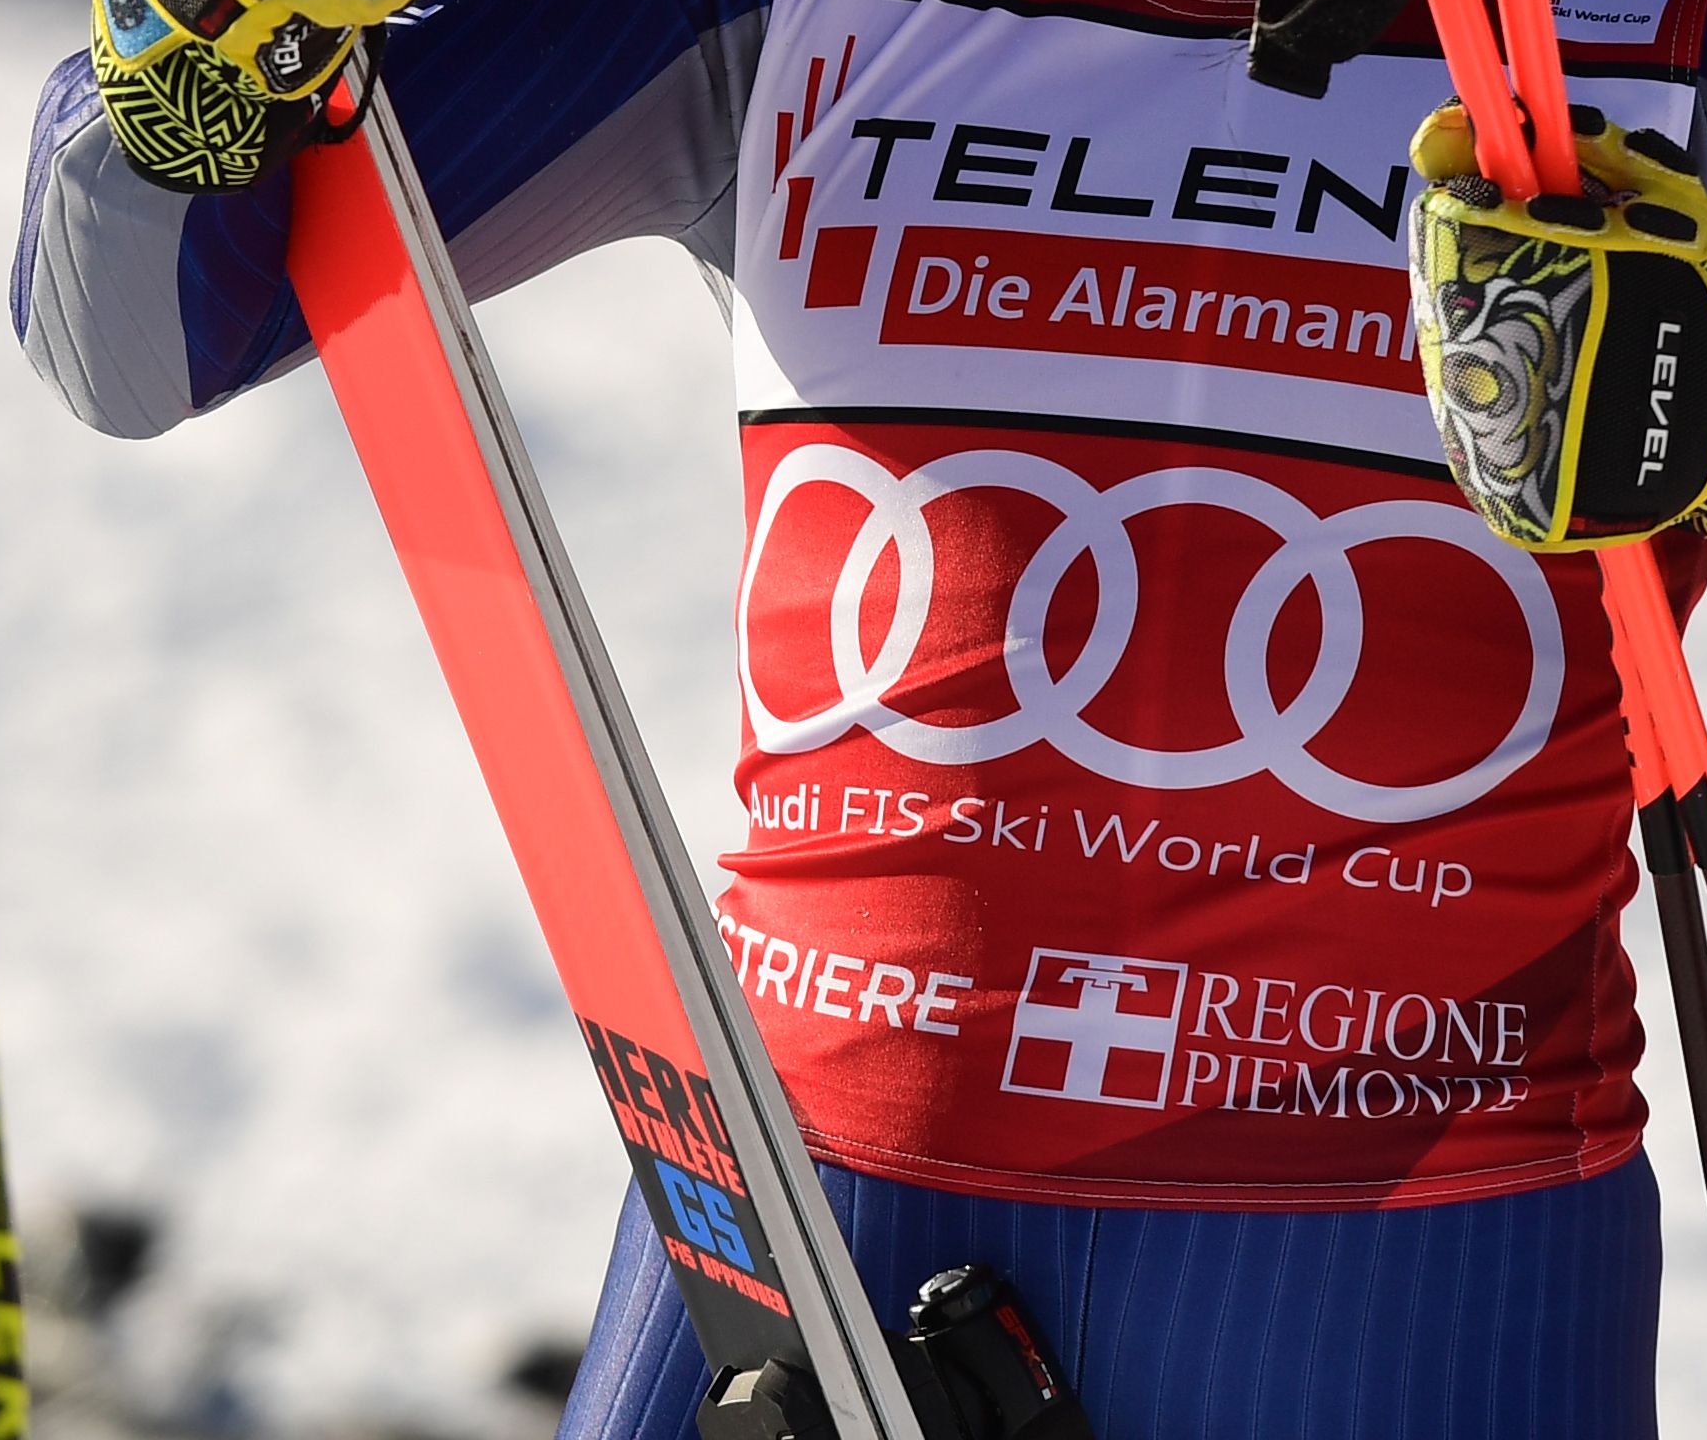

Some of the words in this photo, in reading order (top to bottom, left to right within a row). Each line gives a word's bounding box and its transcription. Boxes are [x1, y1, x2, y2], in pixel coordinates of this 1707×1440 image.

[1575, 9, 1621, 23] World
[1623, 13, 1652, 26] Cup
[850, 118, 1410, 242] TELEN
[906, 254, 1032, 321] Die
[1049, 264, 1416, 363] Alarmanl
[1636, 322, 1683, 487] LEVEL
[750, 780, 822, 834] Audi
[839, 786, 928, 837] FIS
[943, 796, 1050, 853] Ski
[1073, 808, 1316, 886] World
[1343, 846, 1474, 908] Cup
[712, 904, 974, 1037] STRIERE
[1187, 971, 1529, 1067] REGIONE
[1176, 1049, 1532, 1120] PIEMONTE
[616, 1098, 747, 1198] ATHLETE
[655, 1158, 755, 1274] GS
[664, 1233, 699, 1274] FIS
[698, 1254, 792, 1319] APPROVED
